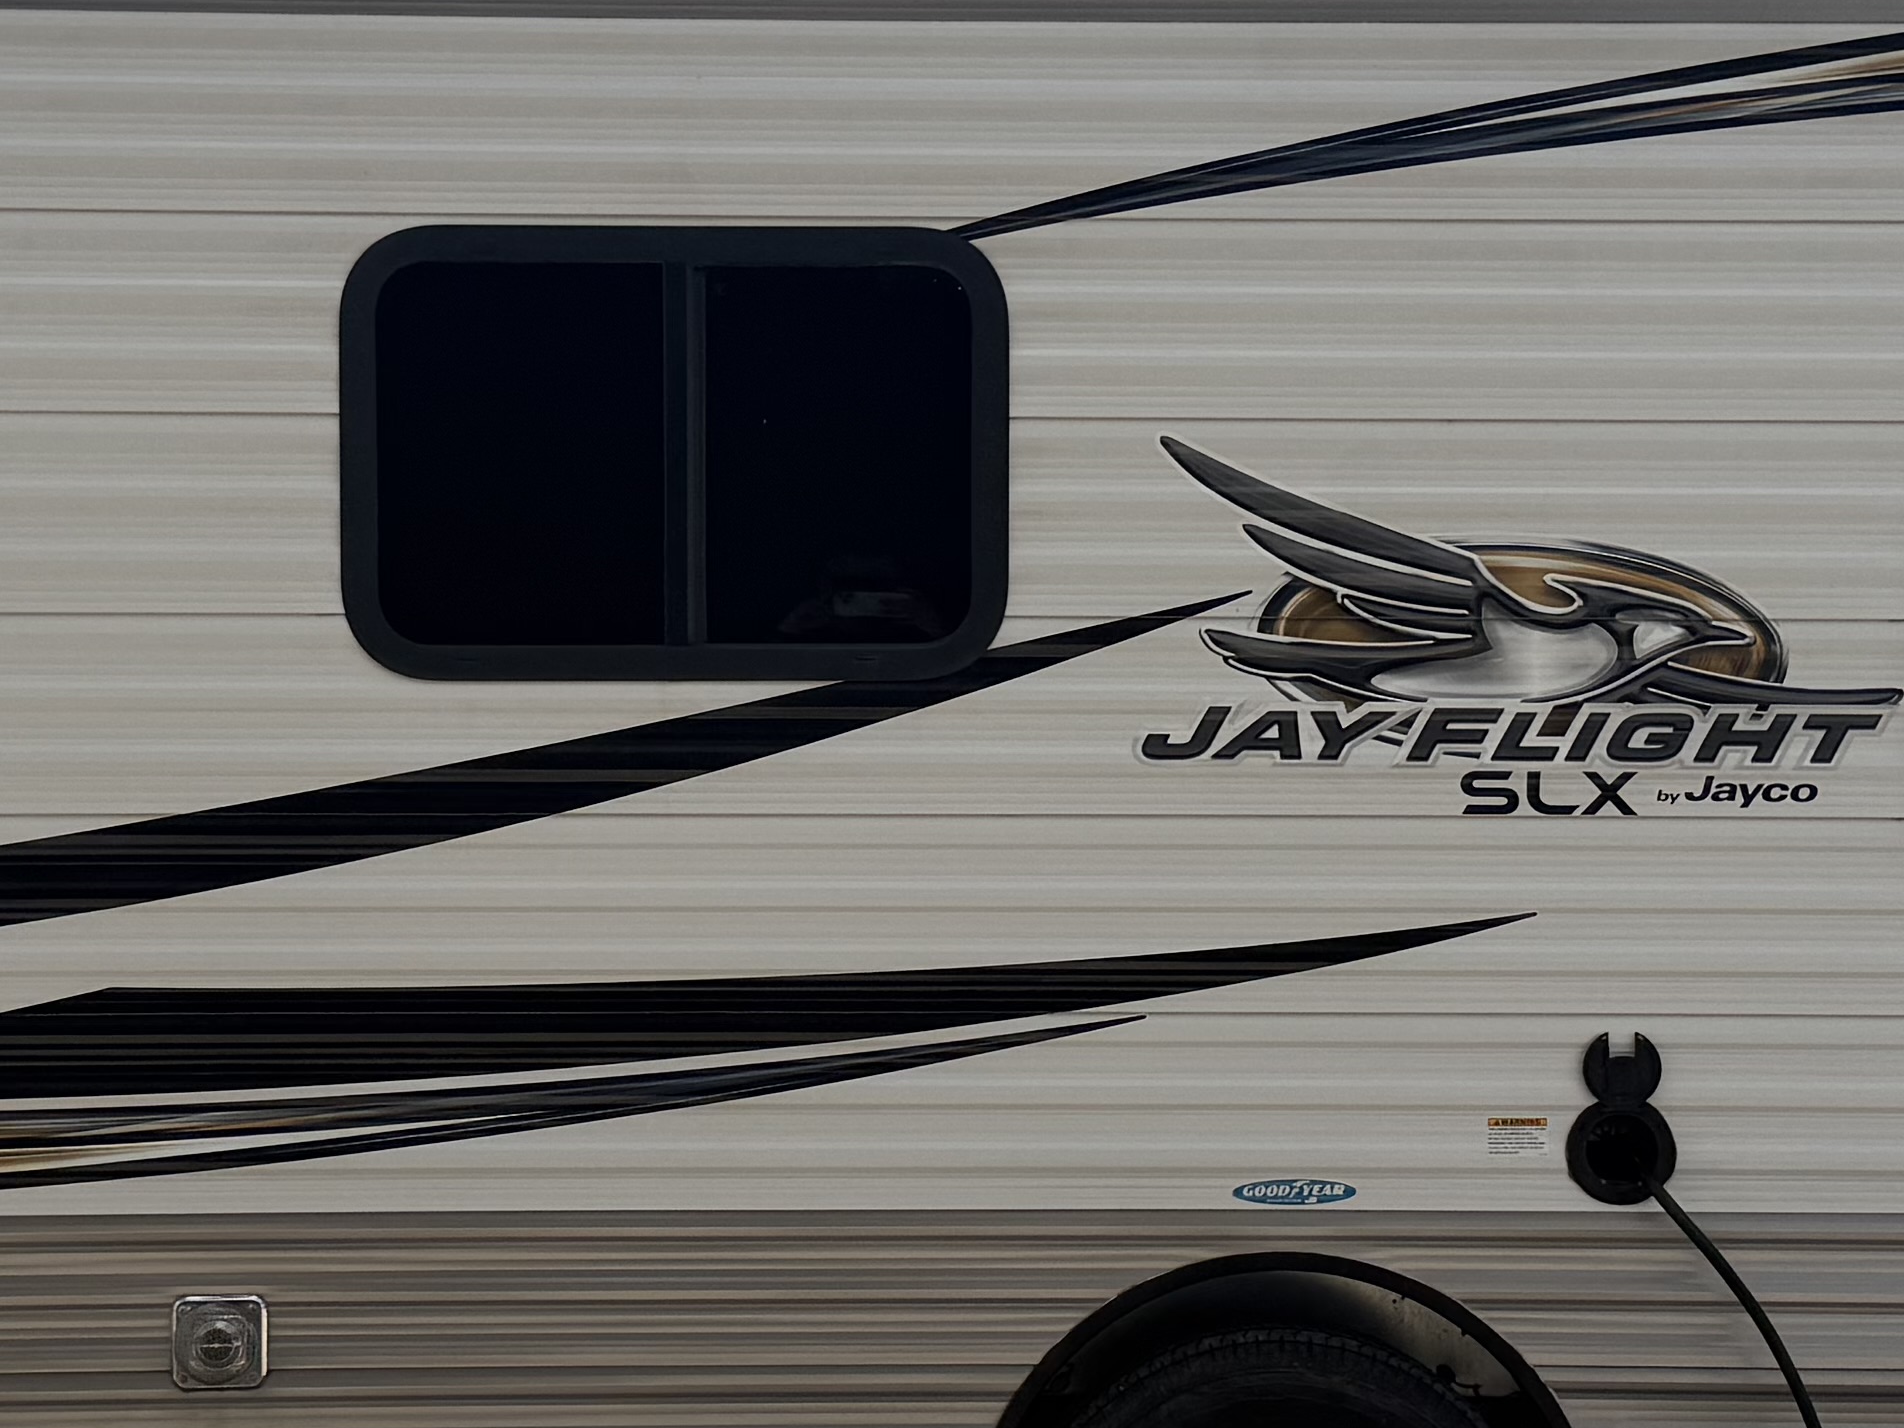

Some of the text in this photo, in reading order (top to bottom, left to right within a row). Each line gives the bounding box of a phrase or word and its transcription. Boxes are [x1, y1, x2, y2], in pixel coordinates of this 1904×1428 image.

[1141, 706, 1883, 764] JAY FLIGHT
[1460, 770, 1818, 815] SLX by Jayco
